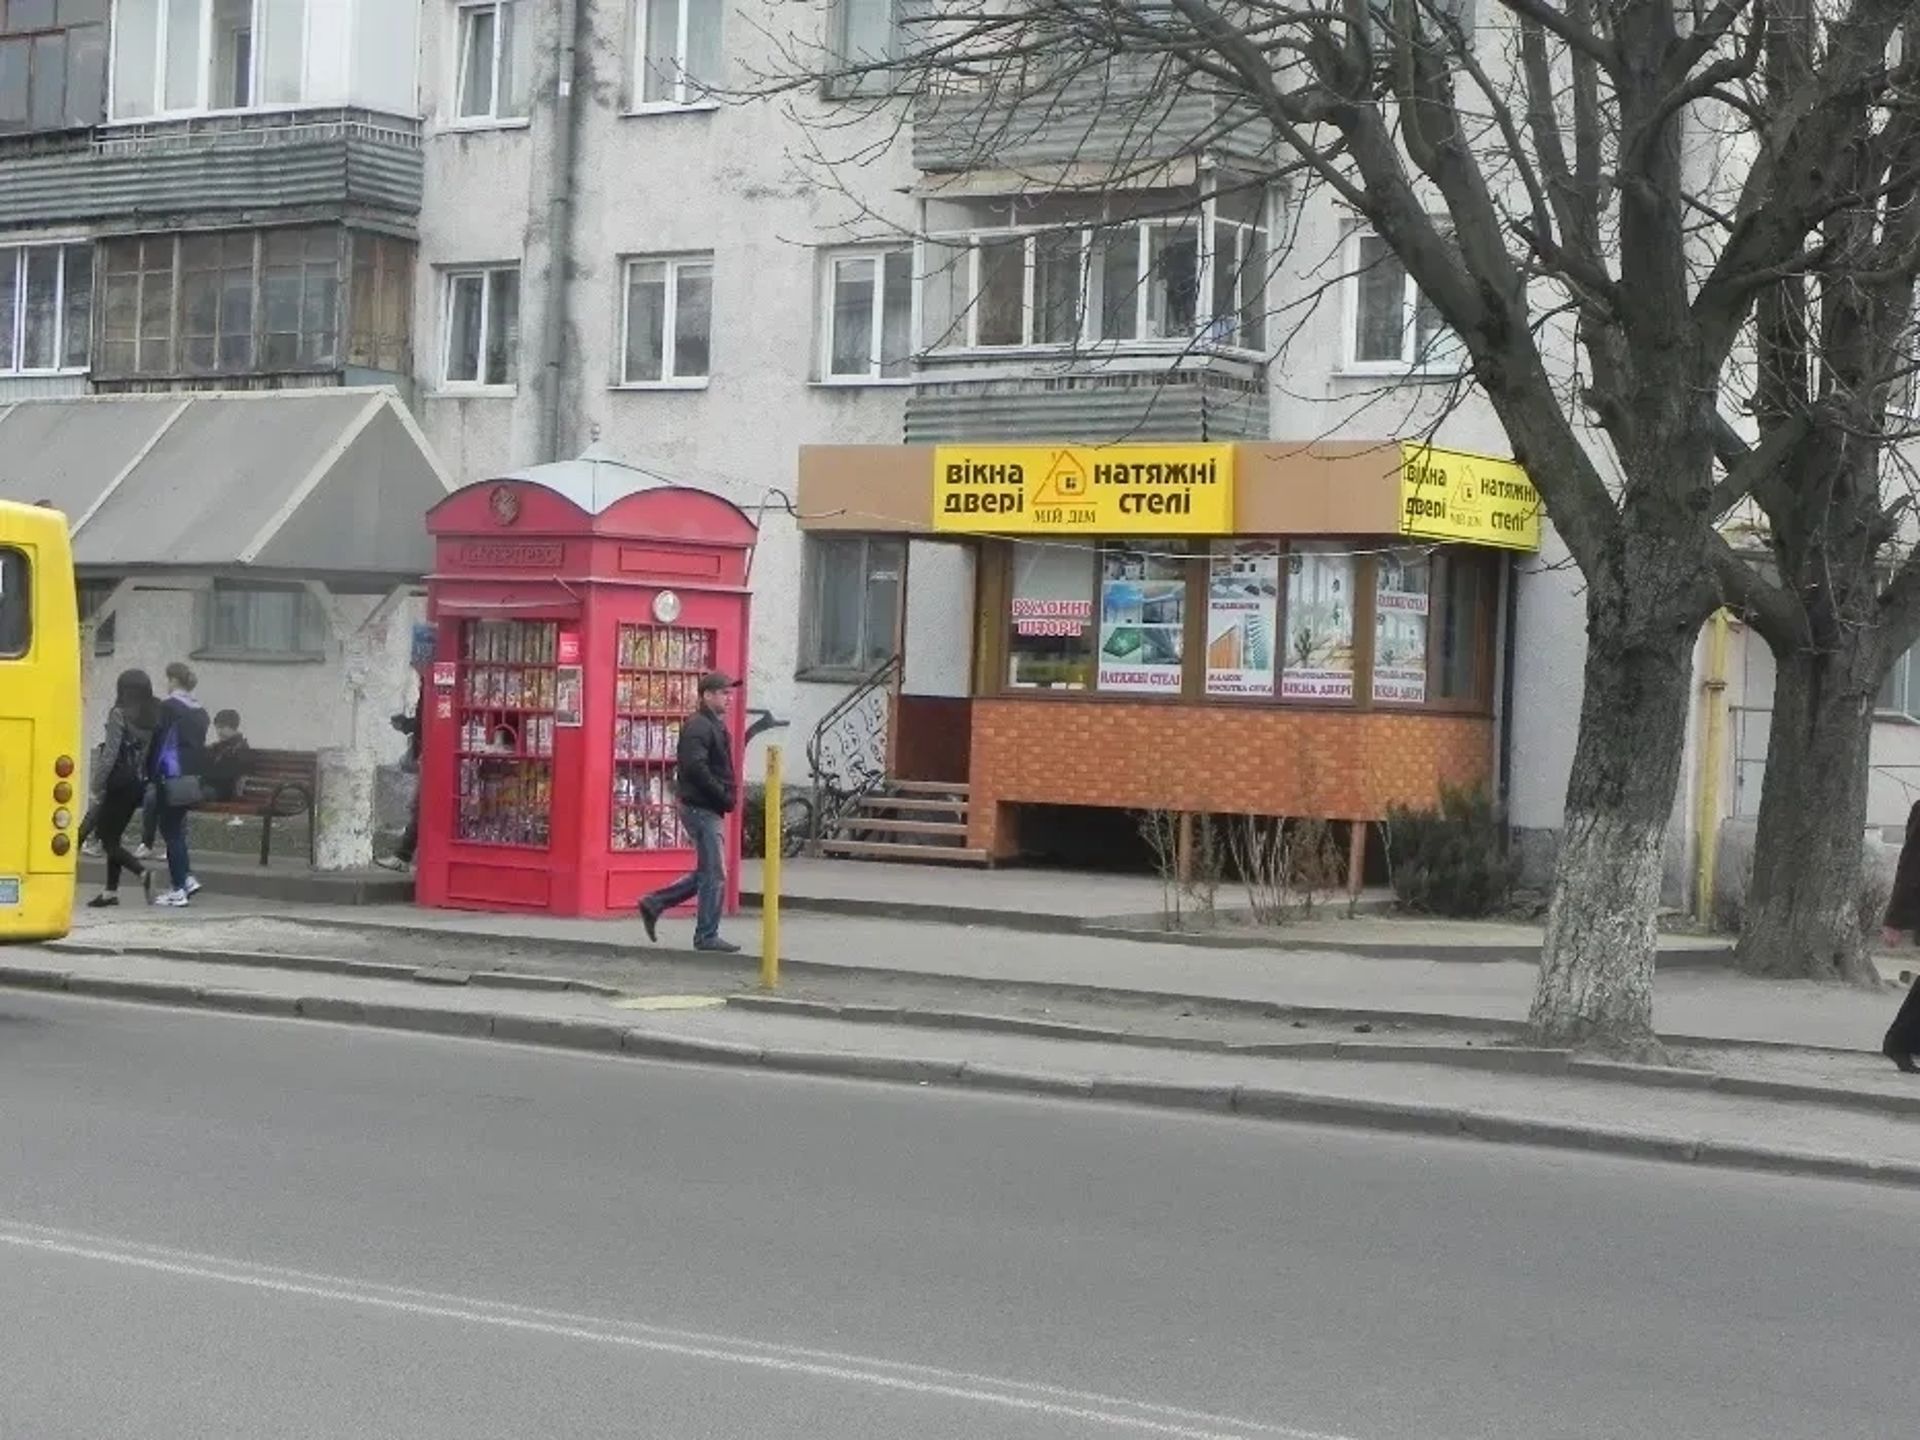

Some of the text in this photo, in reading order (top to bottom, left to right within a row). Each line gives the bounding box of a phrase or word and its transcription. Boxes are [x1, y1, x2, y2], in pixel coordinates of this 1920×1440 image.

[946, 458, 1024, 484] вікна
[1094, 458, 1217, 485] натяжні
[1405, 461, 1447, 486] вікна
[944, 487, 1024, 514] двері
[1119, 487, 1191, 514] стелі
[1405, 496, 1447, 519] двері
[1491, 510, 1525, 532] стелі
